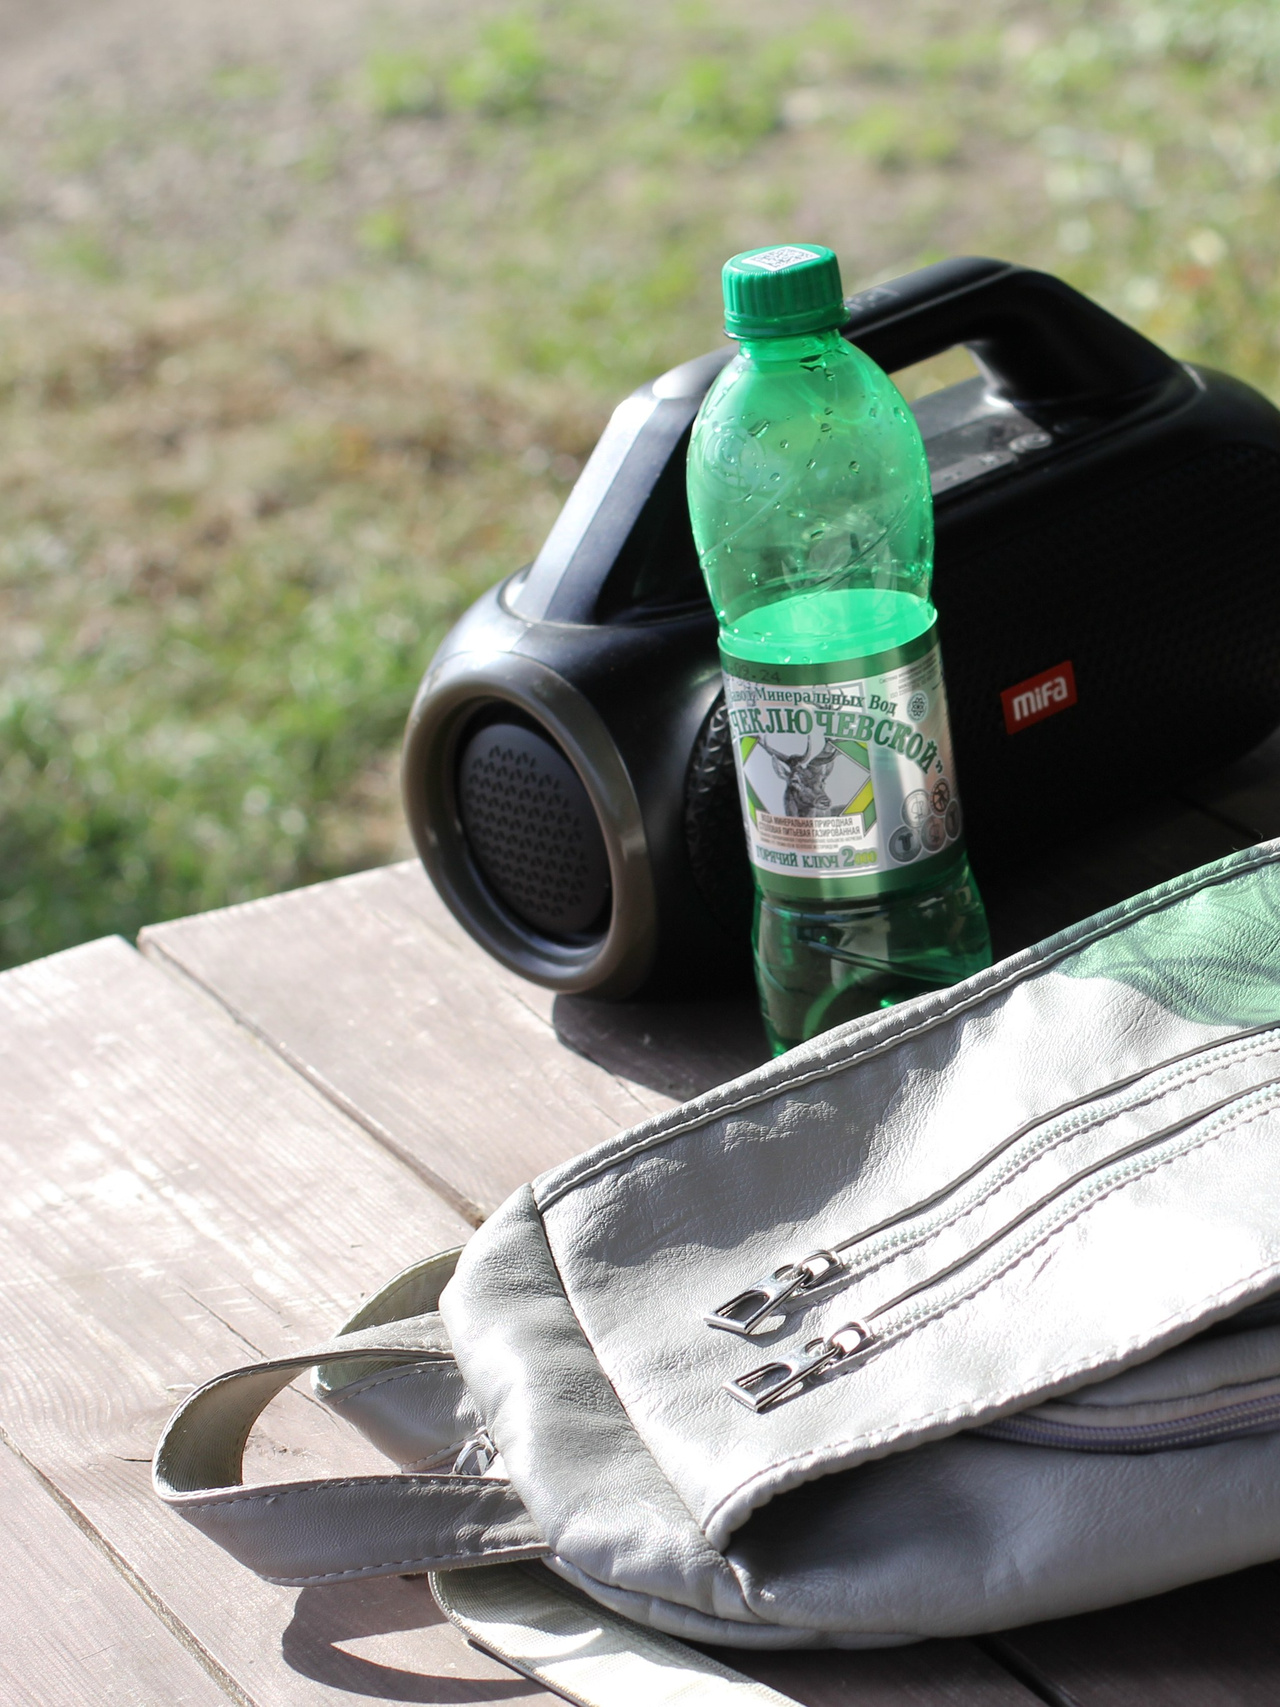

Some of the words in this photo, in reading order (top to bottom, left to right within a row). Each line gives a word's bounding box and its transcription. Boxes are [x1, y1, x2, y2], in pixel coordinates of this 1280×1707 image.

[754, 686, 864, 707] Минеральных
[868, 694, 898, 716] Вод
[815, 817, 853, 828] ПРИРОДНАЯ
[812, 826, 861, 838] ГАЗИРОВАННАЯ
[756, 845, 798, 868] ГОРЯЧИЙ
[802, 855, 839, 869] КЛЮЧ
